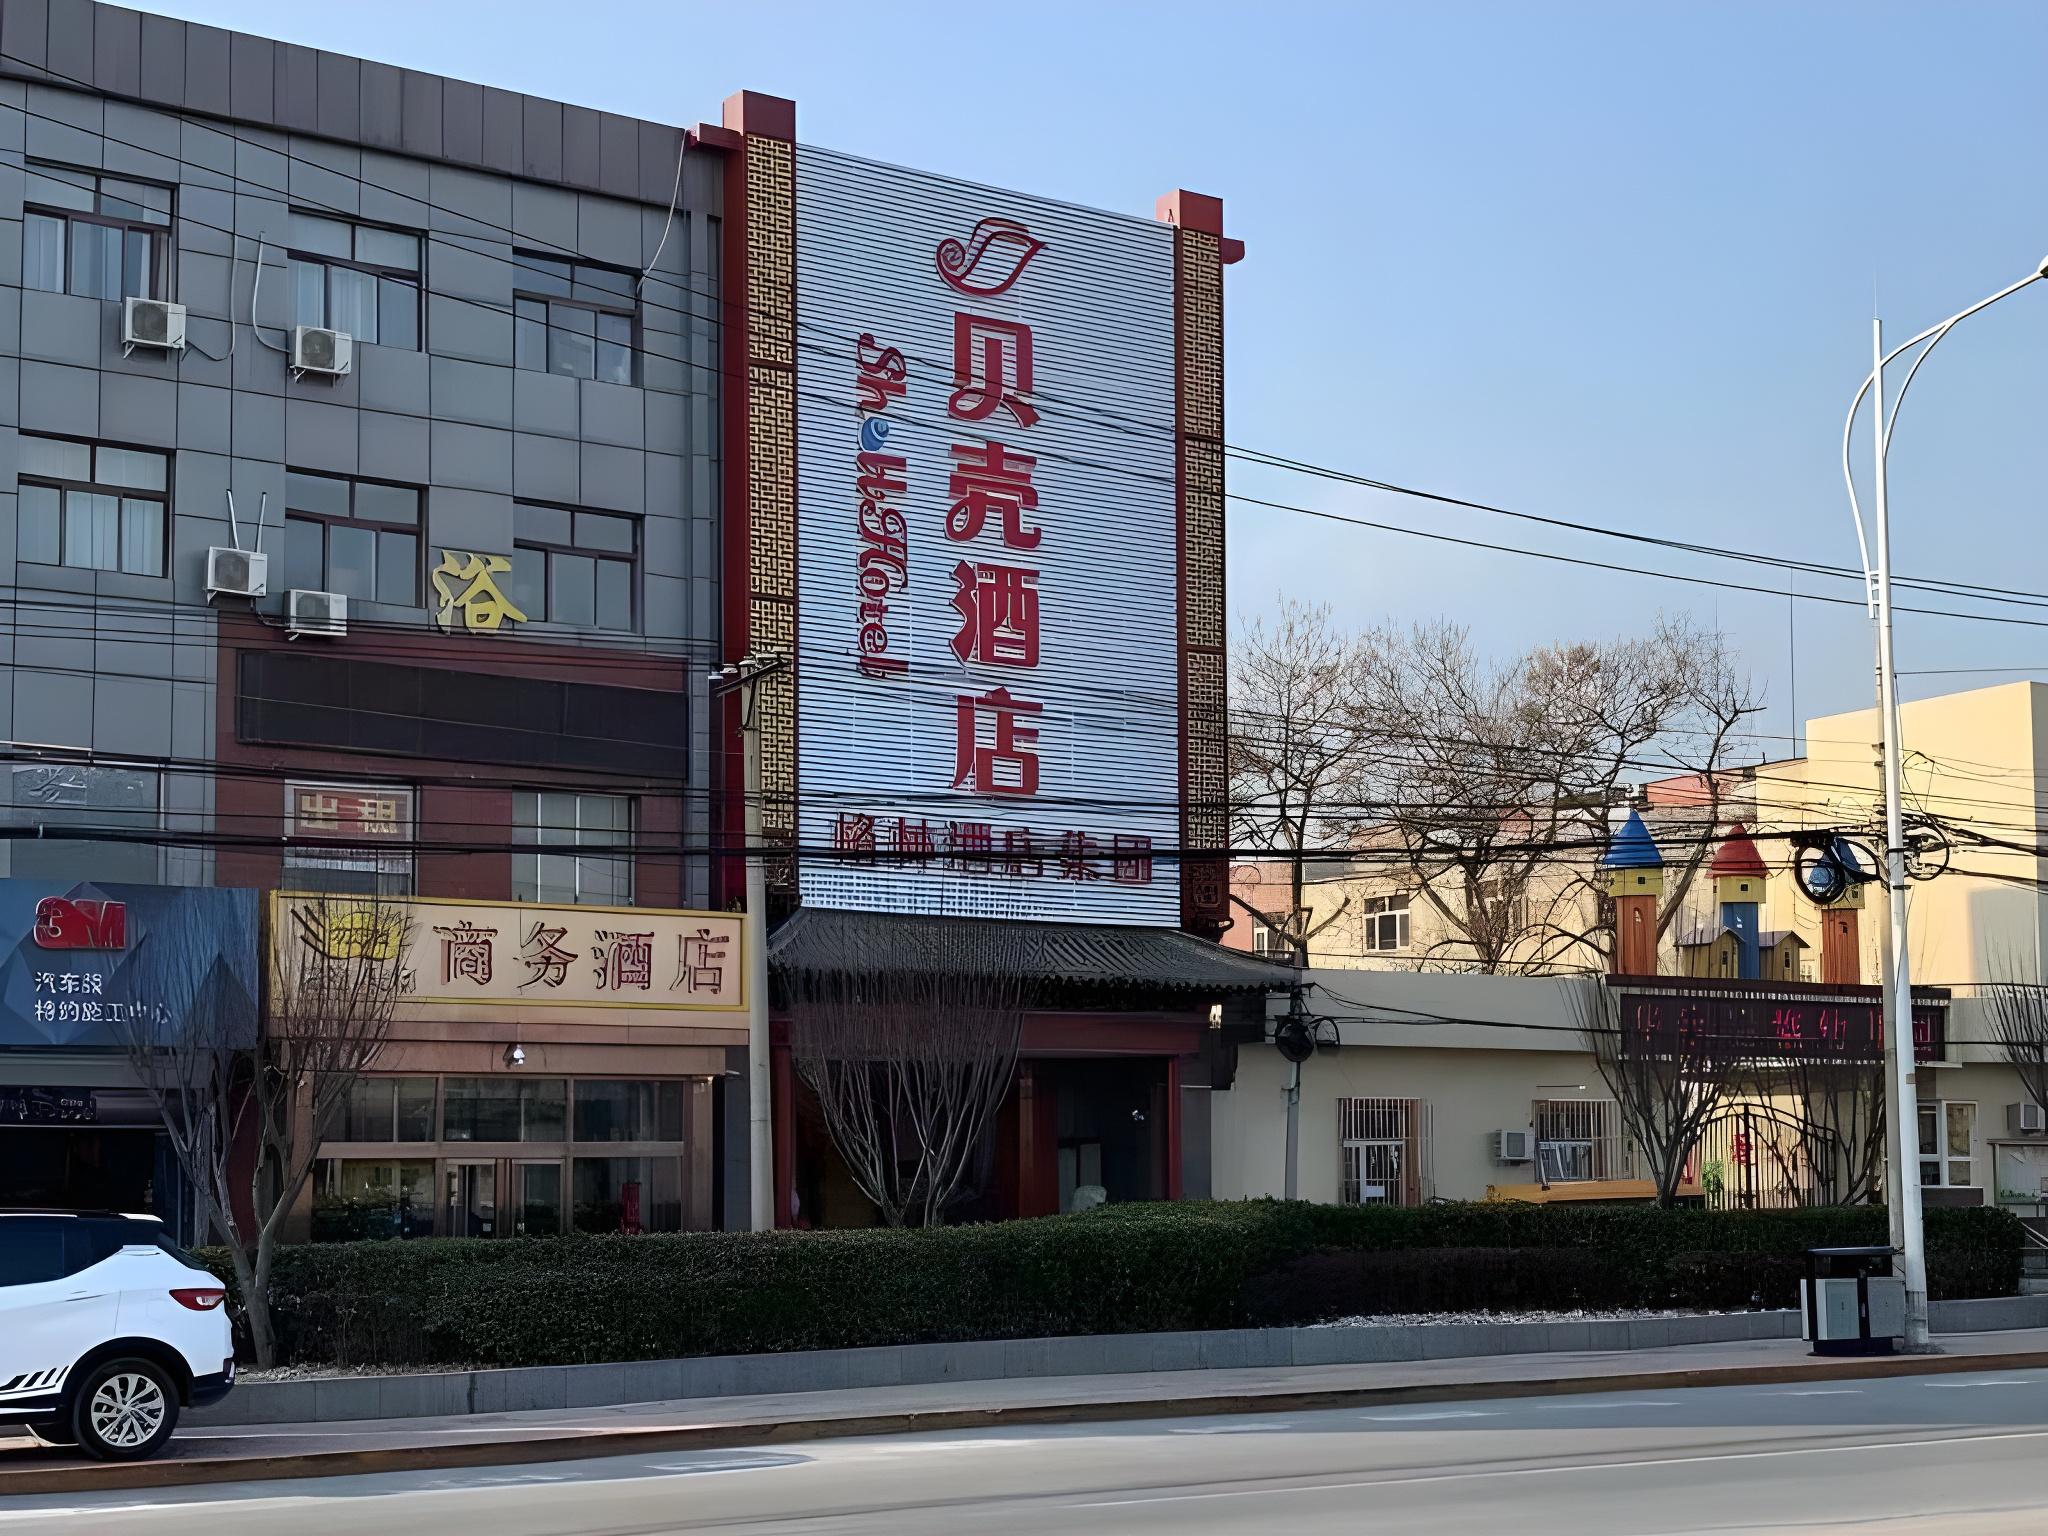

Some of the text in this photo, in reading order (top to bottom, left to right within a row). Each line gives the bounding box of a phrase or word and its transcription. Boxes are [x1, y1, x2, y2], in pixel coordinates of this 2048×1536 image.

[945, 311, 1043, 795] 贝壳酒店
[432, 919, 731, 995] 商务酒店
